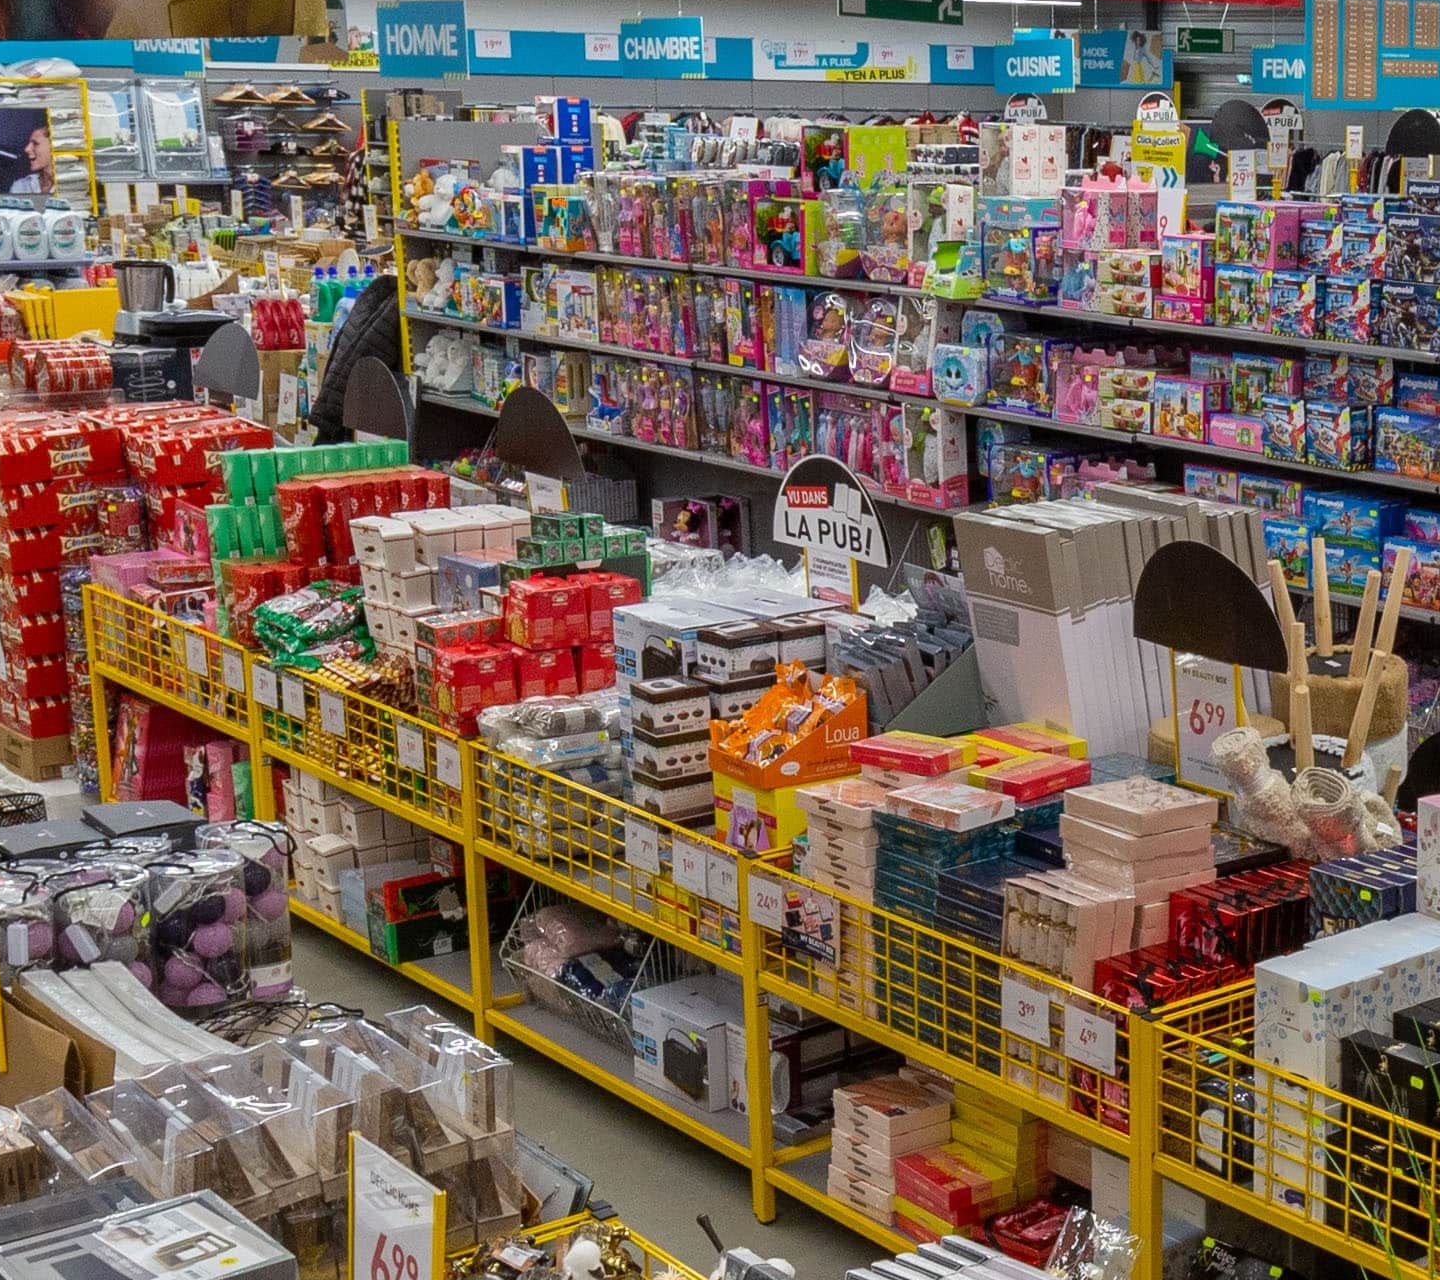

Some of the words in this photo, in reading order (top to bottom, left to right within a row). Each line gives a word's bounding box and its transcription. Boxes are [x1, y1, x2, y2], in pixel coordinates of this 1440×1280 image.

[385, 23, 459, 57] HOMME
[624, 31, 702, 61] CHAMBRE
[1082, 46, 1110, 59] MODE
[870, 70, 877, 80] A
[879, 68, 906, 80] PLUS
[1006, 56, 1062, 77] CUISINE
[1082, 59, 1115, 71] FEMME
[1262, 58, 1305, 79] FEMM
[787, 489, 801, 504] VU
[802, 490, 828, 506] DANS
[784, 510, 812, 542] LA
[819, 521, 873, 557] PUB!
[1189, 697, 1227, 735] 699
[824, 721, 862, 745] Loua
